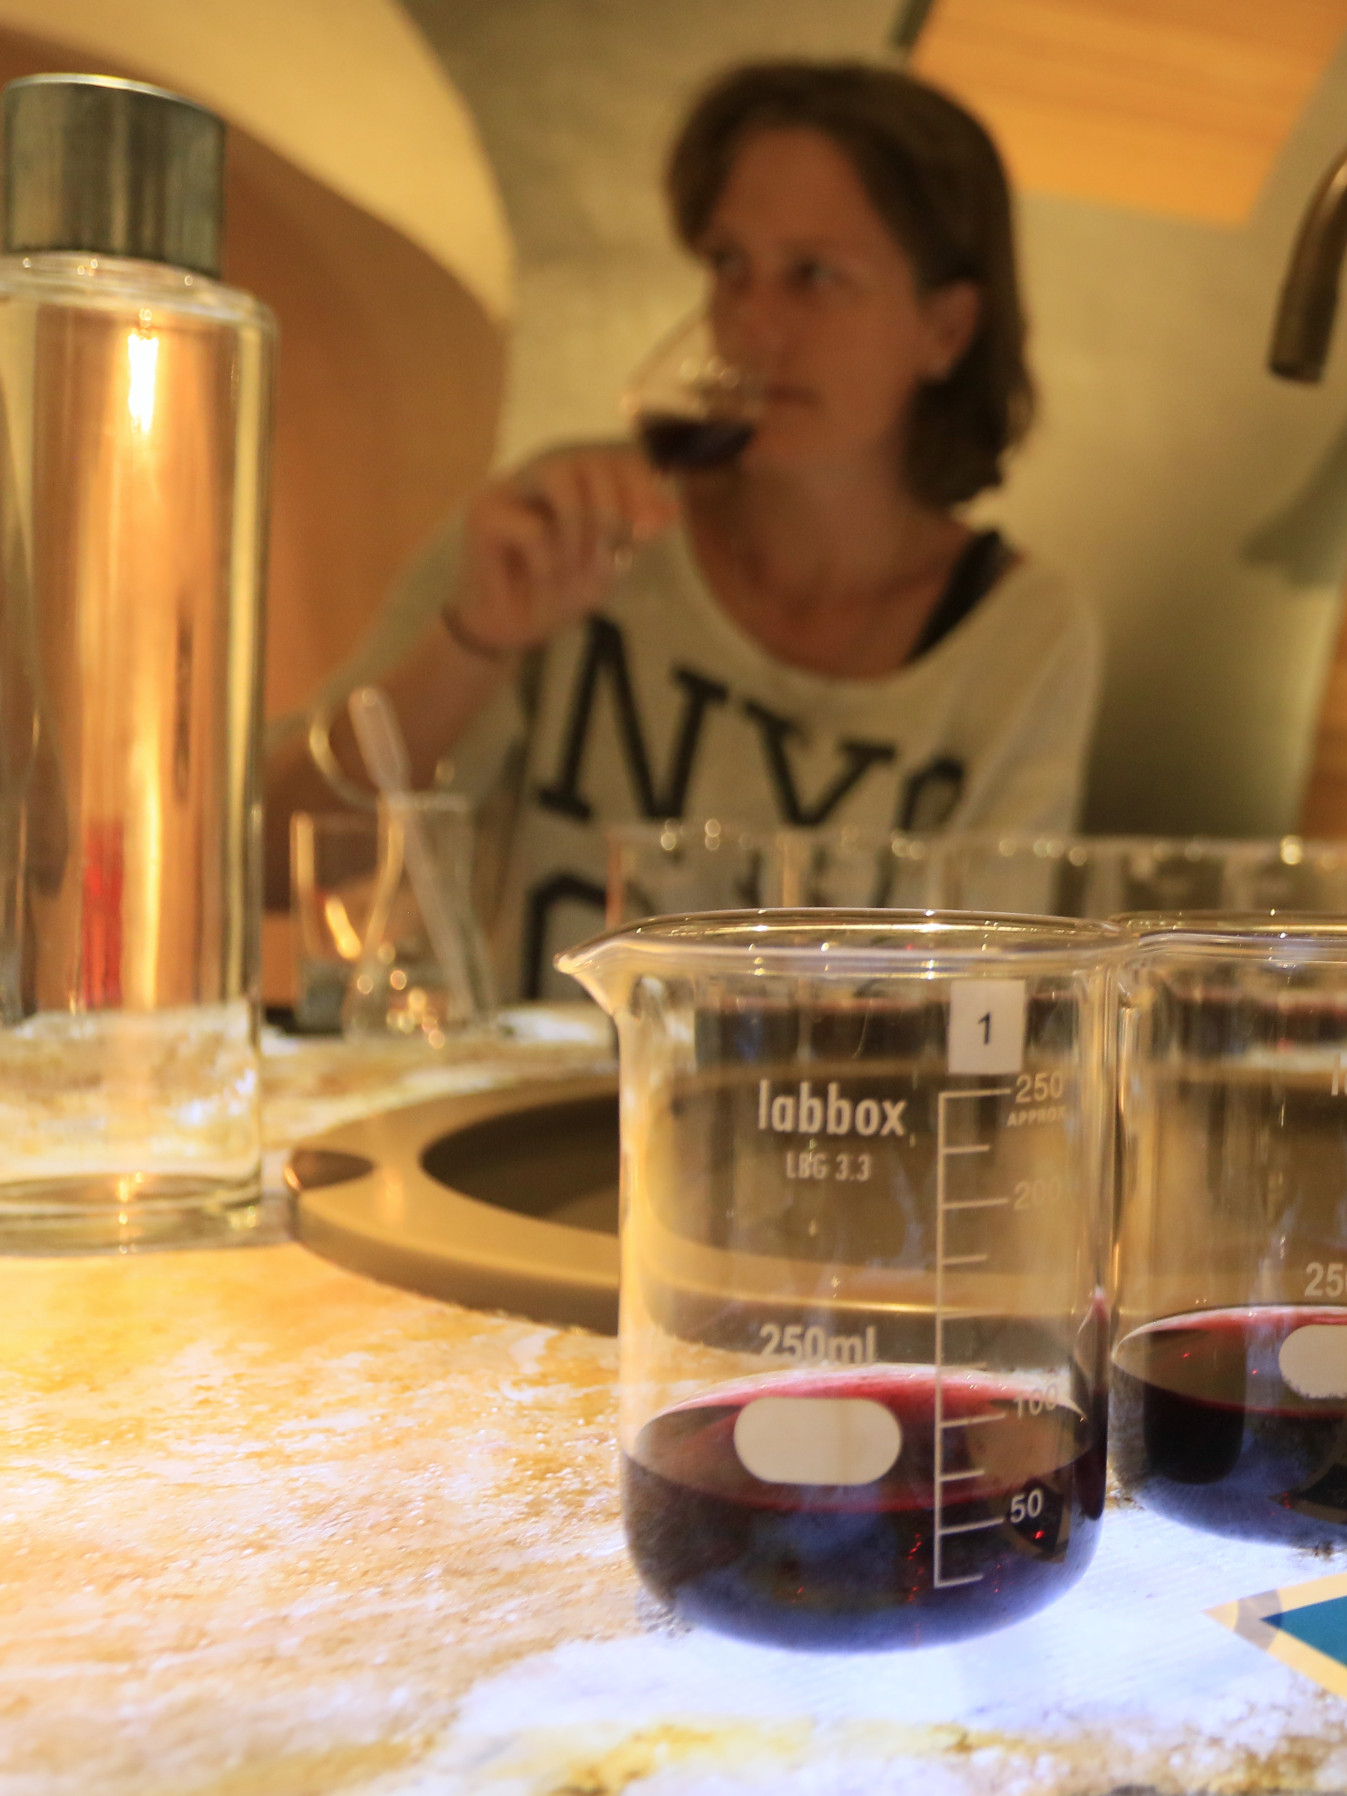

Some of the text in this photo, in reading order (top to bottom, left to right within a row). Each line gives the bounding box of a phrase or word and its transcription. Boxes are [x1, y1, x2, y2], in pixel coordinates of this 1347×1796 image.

[978, 1011, 992, 1046] 1
[1014, 1072, 1064, 1104] 250
[758, 1078, 908, 1137] labbox
[785, 1151, 872, 1182] LBG 3.3
[759, 1323, 879, 1365] 250ml
[1013, 1381, 1059, 1419] 100
[1009, 1488, 1044, 1524] 50
